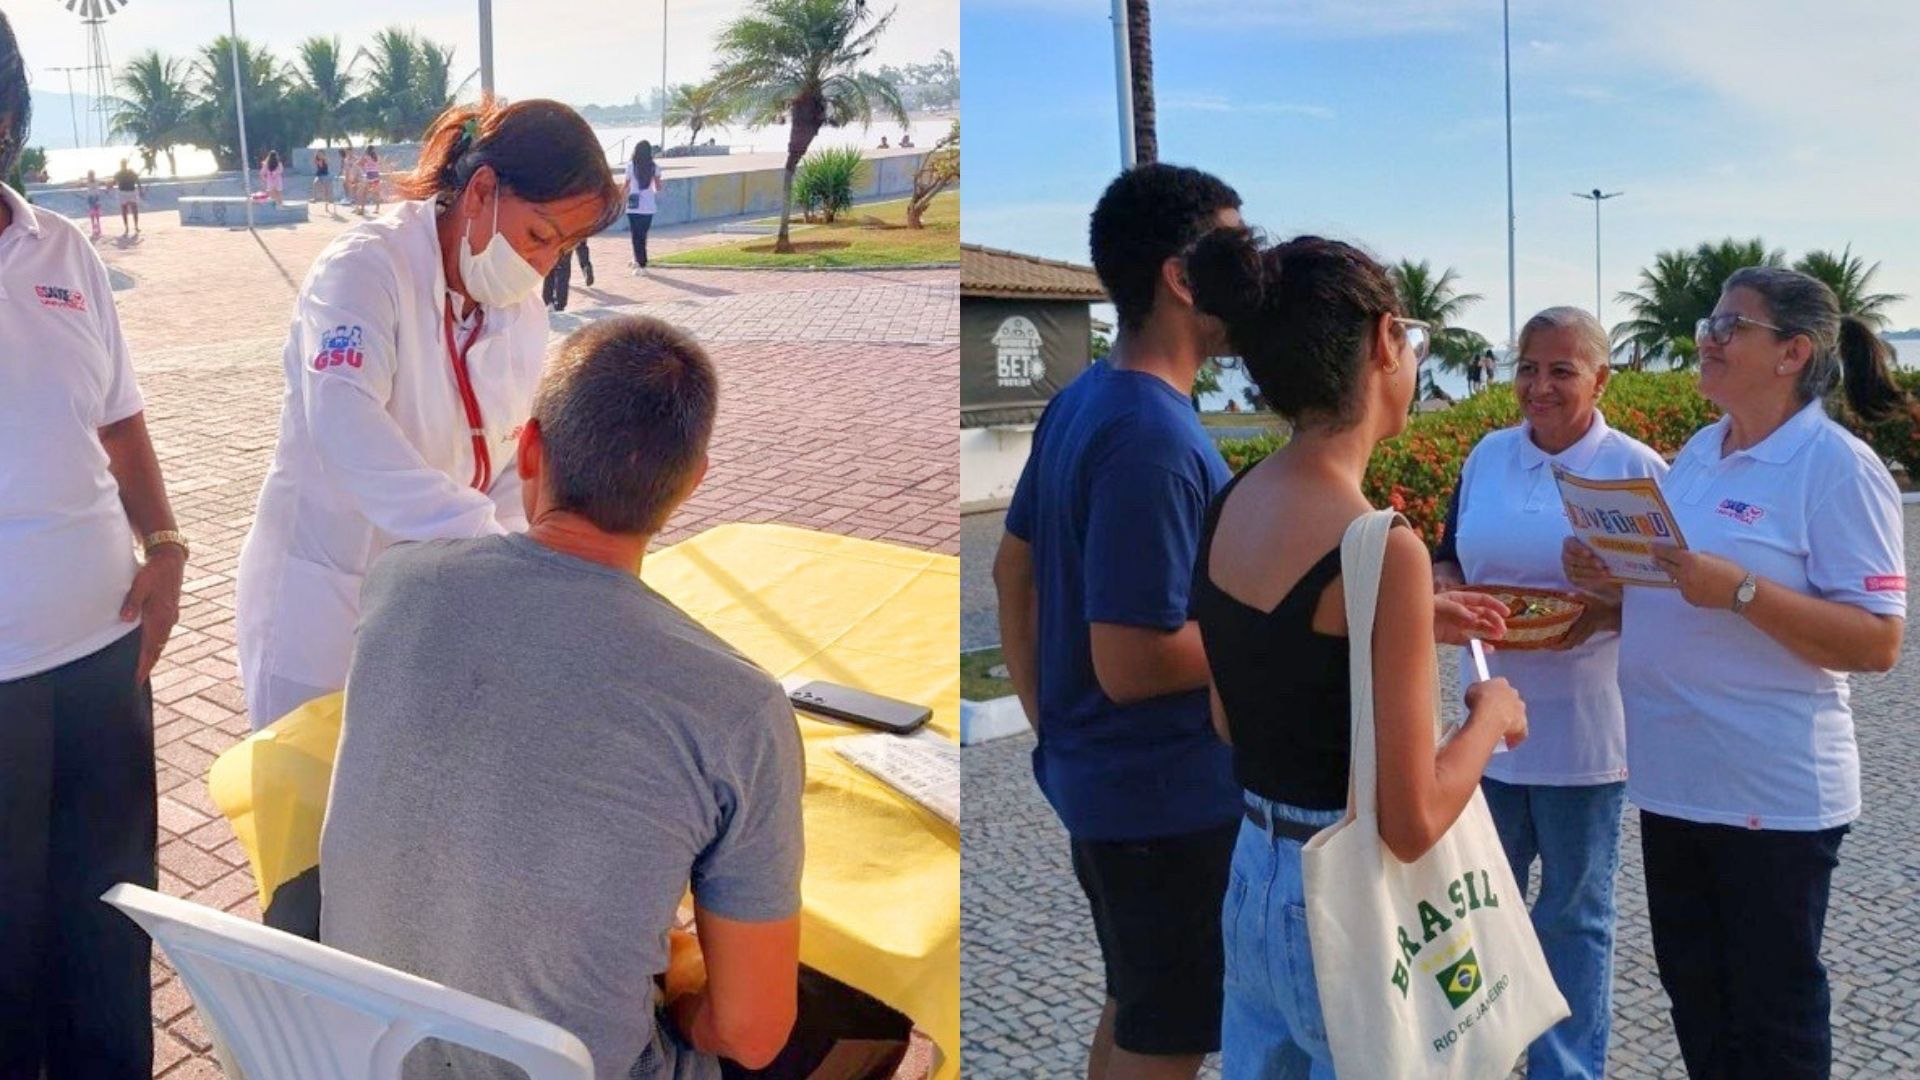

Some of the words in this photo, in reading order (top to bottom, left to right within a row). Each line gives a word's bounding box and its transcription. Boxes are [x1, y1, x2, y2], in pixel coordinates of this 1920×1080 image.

[314, 348, 363, 371] GSU
[1391, 869, 1499, 1001] BRASIL
[1433, 1030, 1459, 1053] RIO
[1458, 1014, 1474, 1035] DE
[1475, 973, 1510, 1020] JANEIRO
